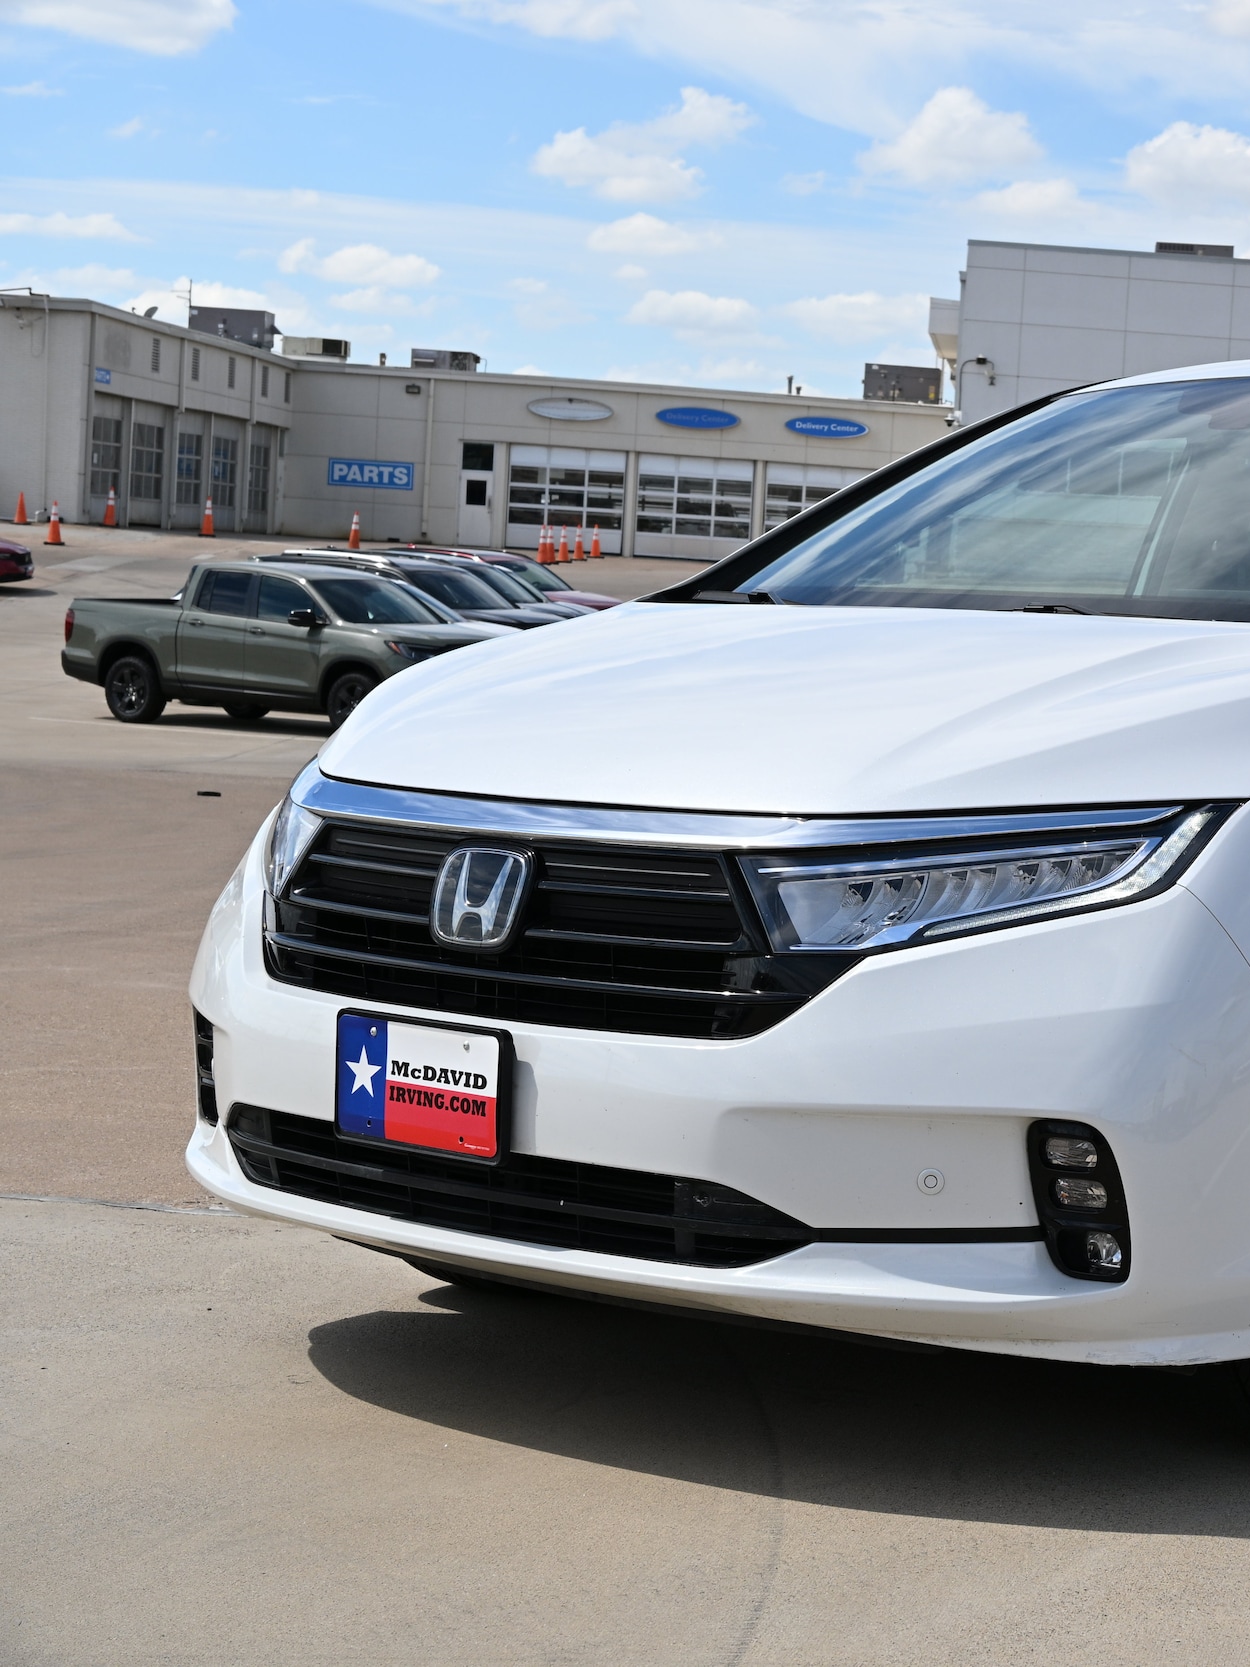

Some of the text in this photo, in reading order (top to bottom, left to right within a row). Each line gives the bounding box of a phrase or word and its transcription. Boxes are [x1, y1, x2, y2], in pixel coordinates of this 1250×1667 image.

[795, 421, 859, 432] Delivery Center
[333, 463, 408, 485] PARTS
[390, 1060, 487, 1089] McDAVID
[389, 1085, 487, 1117] IRVING.COM
